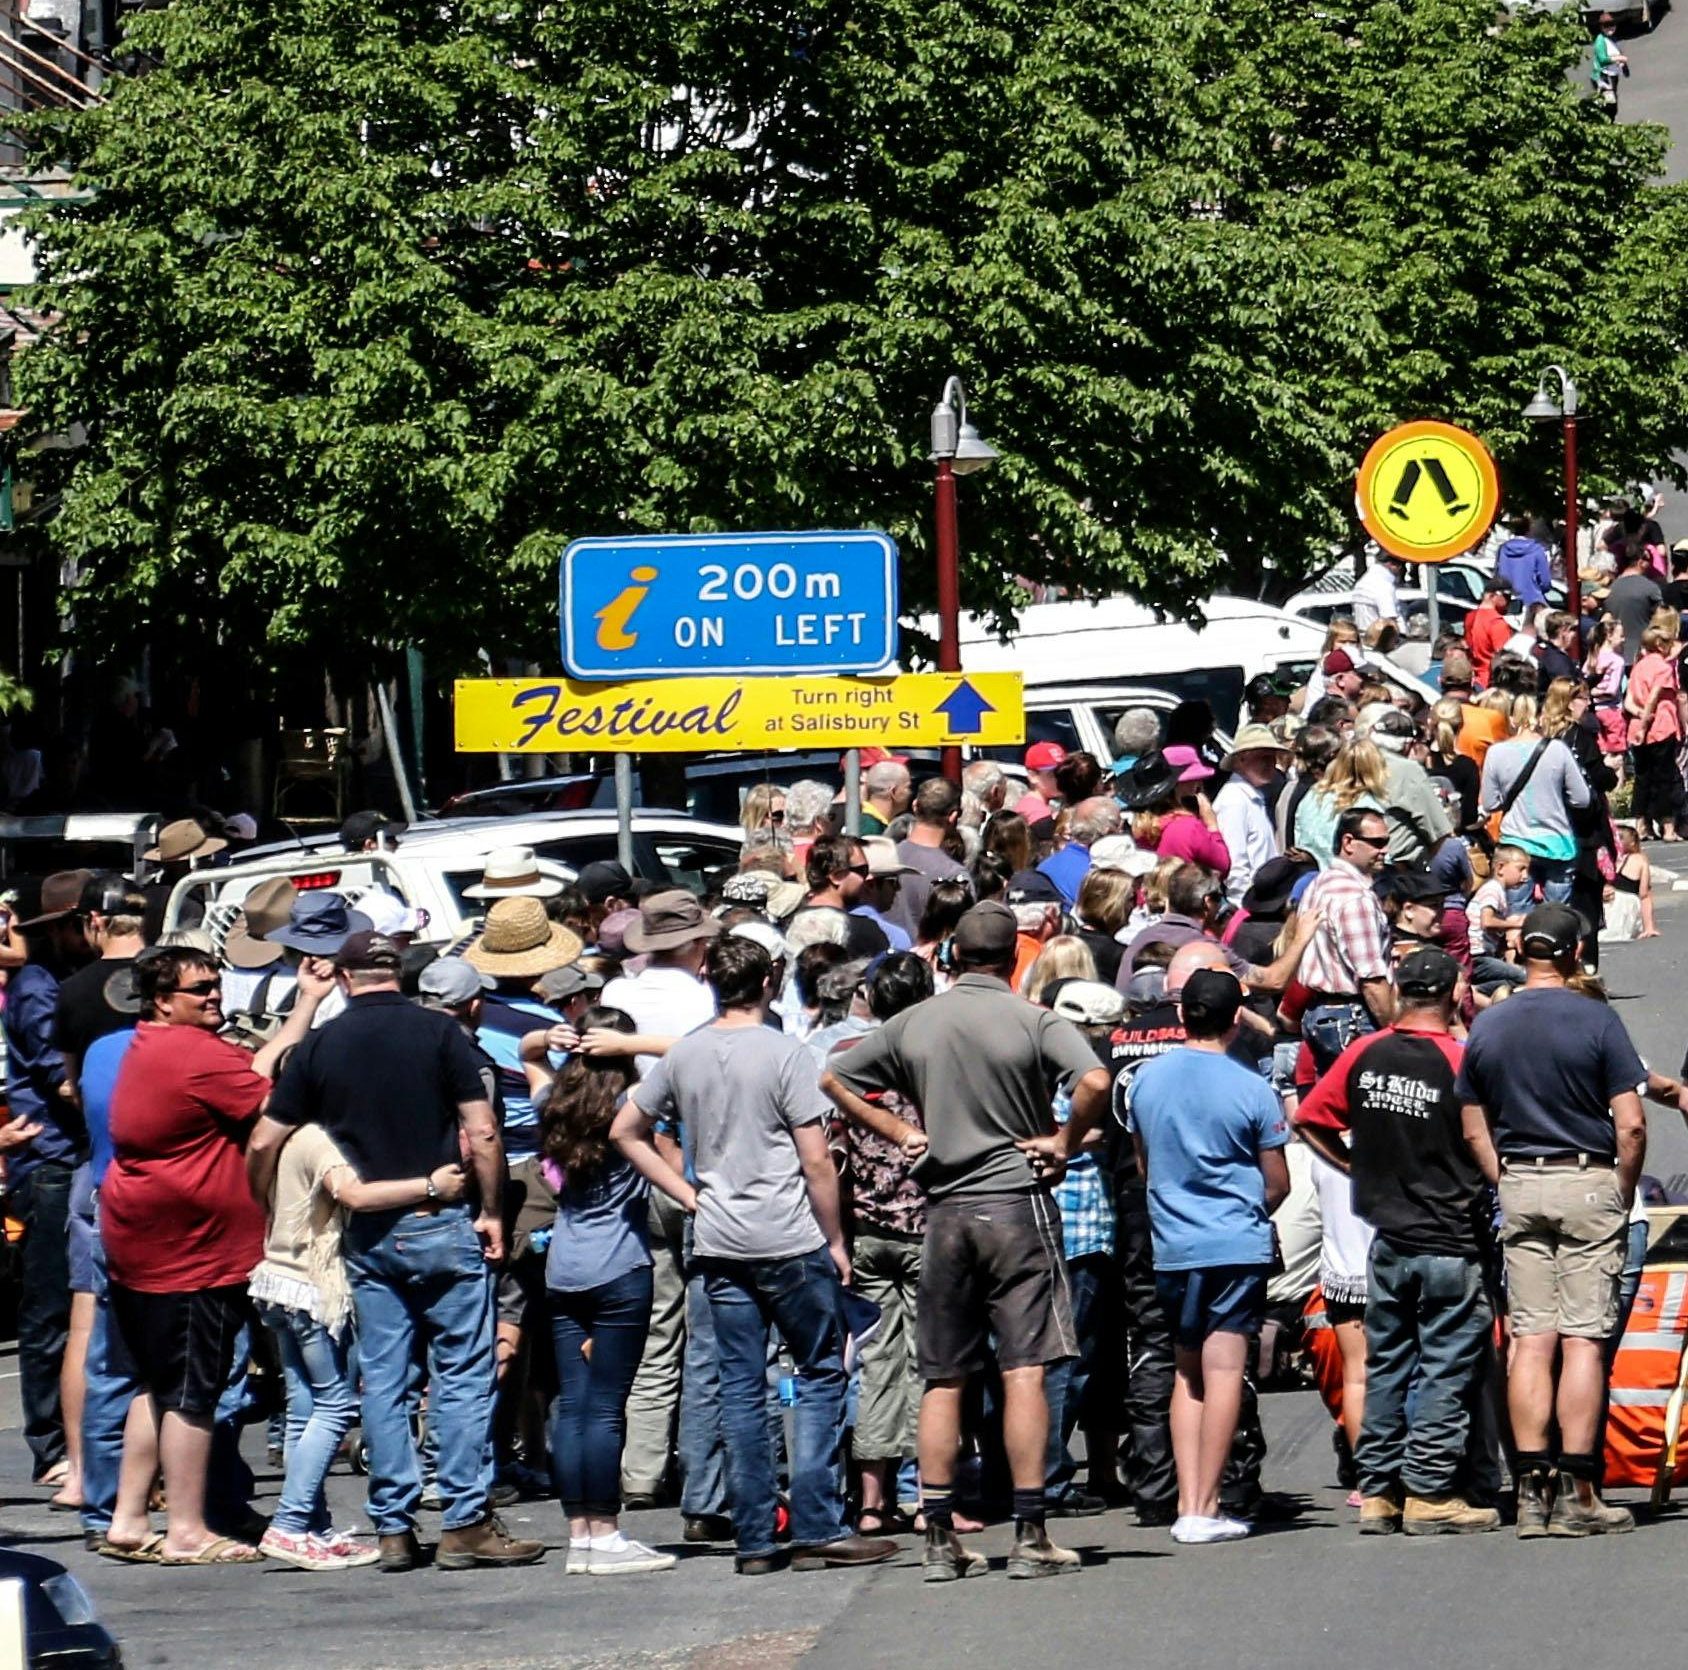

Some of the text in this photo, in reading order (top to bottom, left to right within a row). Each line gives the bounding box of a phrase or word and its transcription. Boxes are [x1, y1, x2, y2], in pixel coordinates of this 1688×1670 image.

[698, 563, 842, 601] 200m
[674, 612, 867, 648] ON LEFT
[791, 686, 894, 709] Turn right
[511, 684, 744, 748] Festival
[765, 711, 920, 734] at Salisbury St
[1358, 1070, 1440, 1104] St Kilda
[1367, 1090, 1426, 1112] HOTEL
